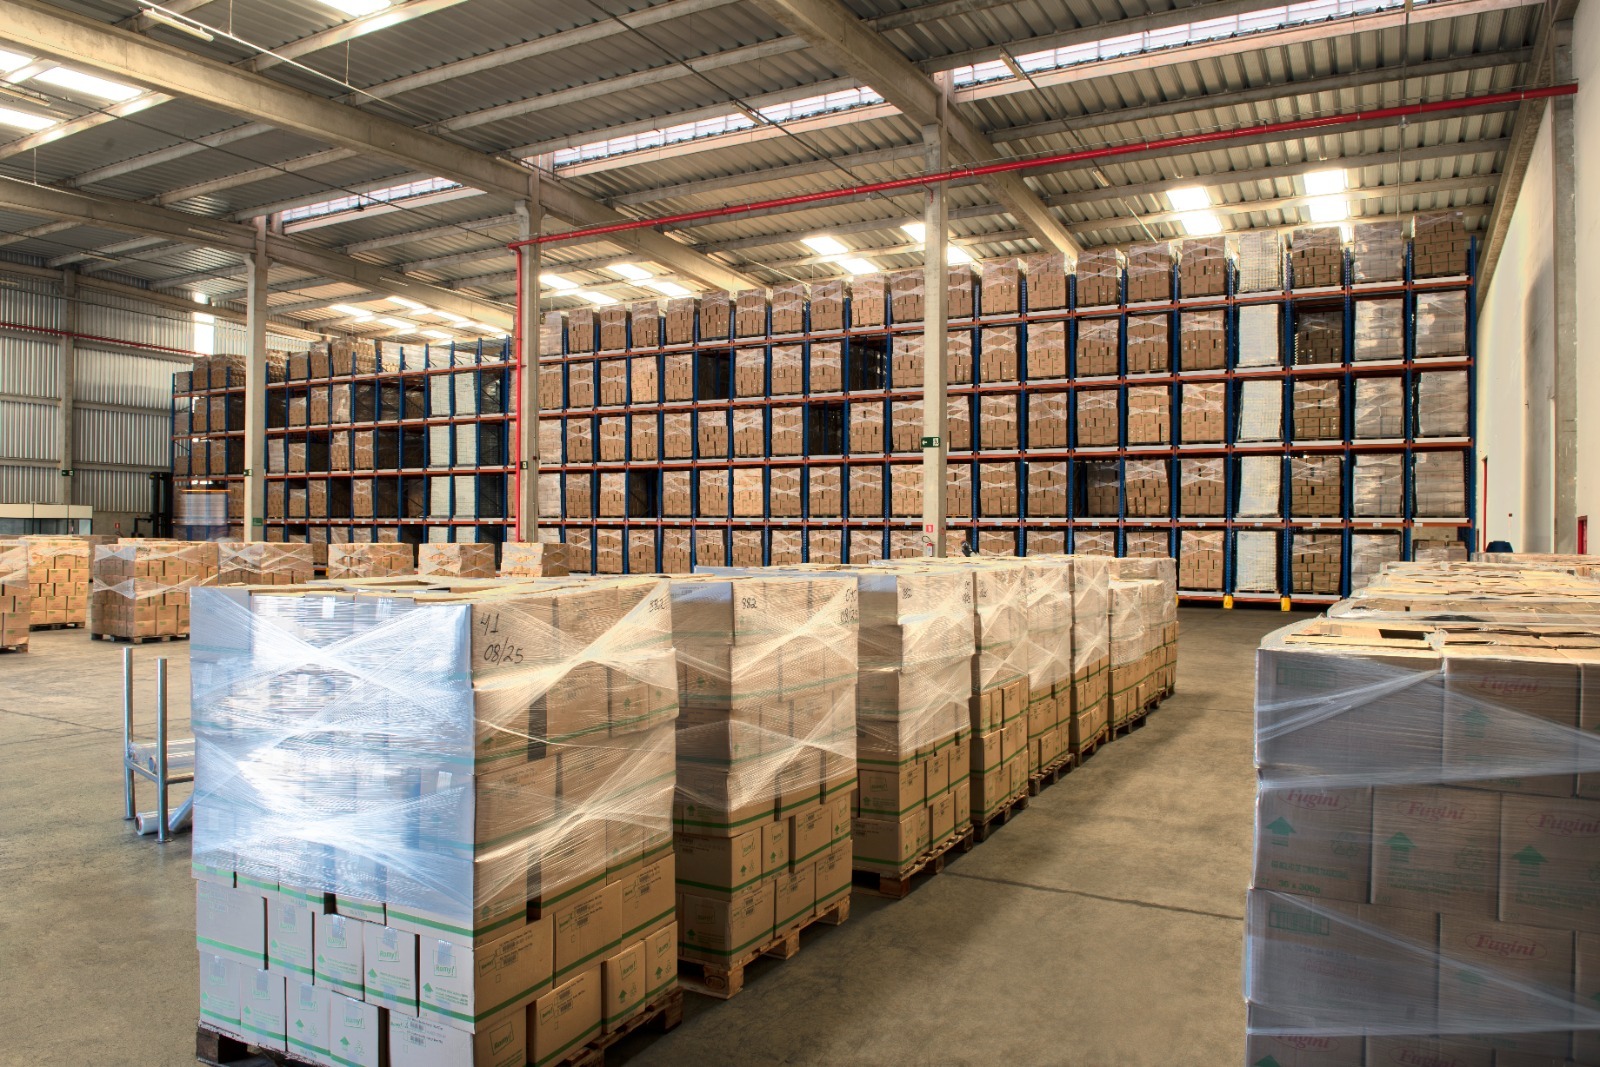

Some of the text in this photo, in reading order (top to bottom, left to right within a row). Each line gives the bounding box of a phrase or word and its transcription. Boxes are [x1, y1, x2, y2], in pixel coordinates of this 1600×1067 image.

[480, 612, 500, 636] 41
[483, 637, 524, 666] 08/25
[1479, 676, 1540, 695] Fugini
[1407, 801, 1467, 822] Fugini
[1539, 814, 1600, 834] Fugini
[1476, 933, 1537, 956] Fugini
